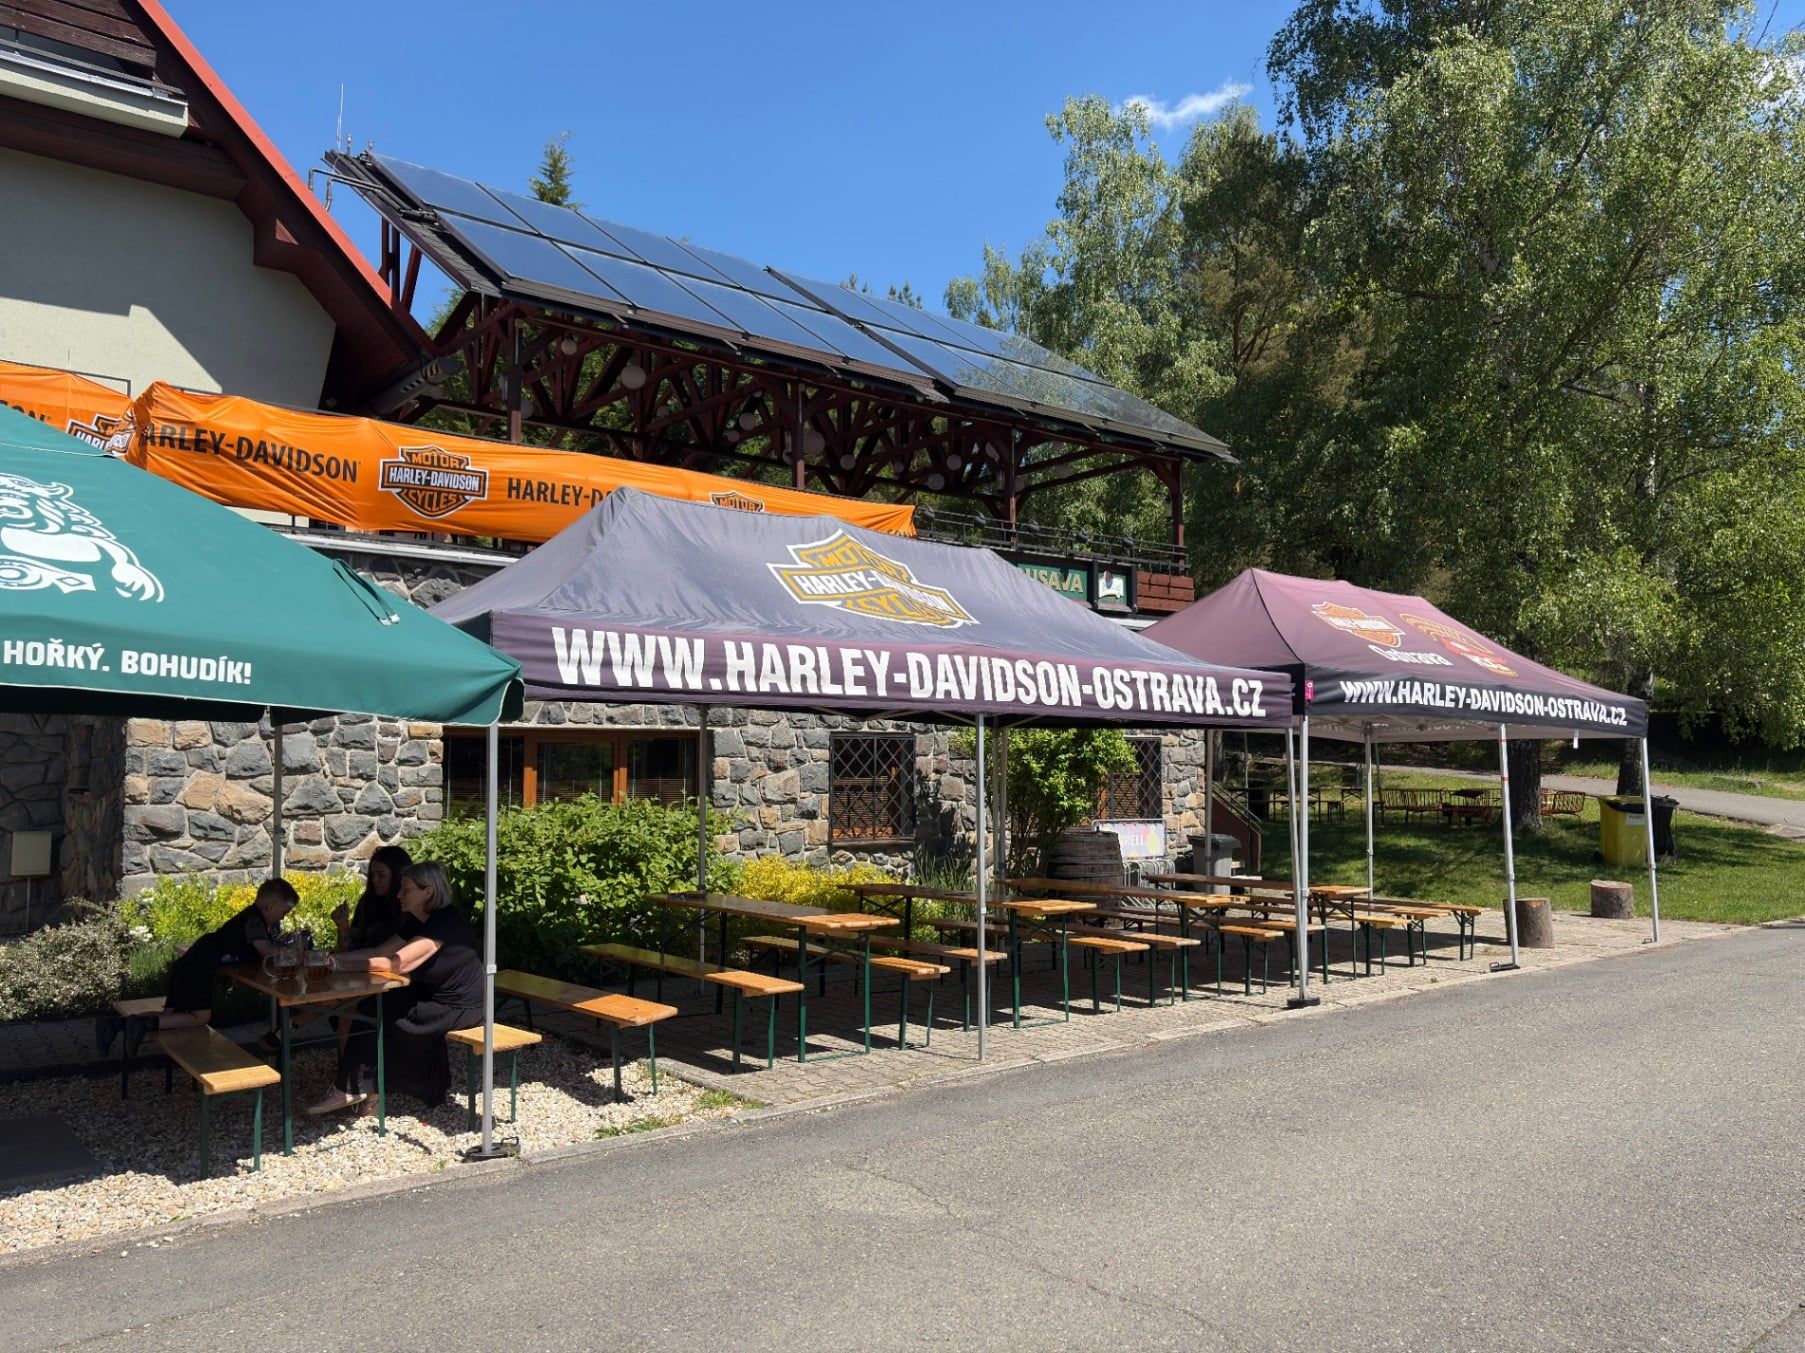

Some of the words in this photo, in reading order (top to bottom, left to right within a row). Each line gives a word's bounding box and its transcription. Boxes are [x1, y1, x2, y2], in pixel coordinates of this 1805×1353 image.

[411, 450, 461, 469] MOTOR
[388, 466, 480, 492] HARLEY-DAVIDSON
[507, 477, 612, 508] HARLEY-D
[408, 488, 457, 512] CYCLES
[3, 637, 110, 672] HOŘKÝ.
[121, 650, 252, 685] BOHUDÍK!
[550, 626, 1267, 718] WWW.HARLEY-DAVIDSON-OSTRAVA.CZ
[1339, 680, 1628, 726] WWW.HARLEY-DAVIDSON-OSTRAVA.CZ
